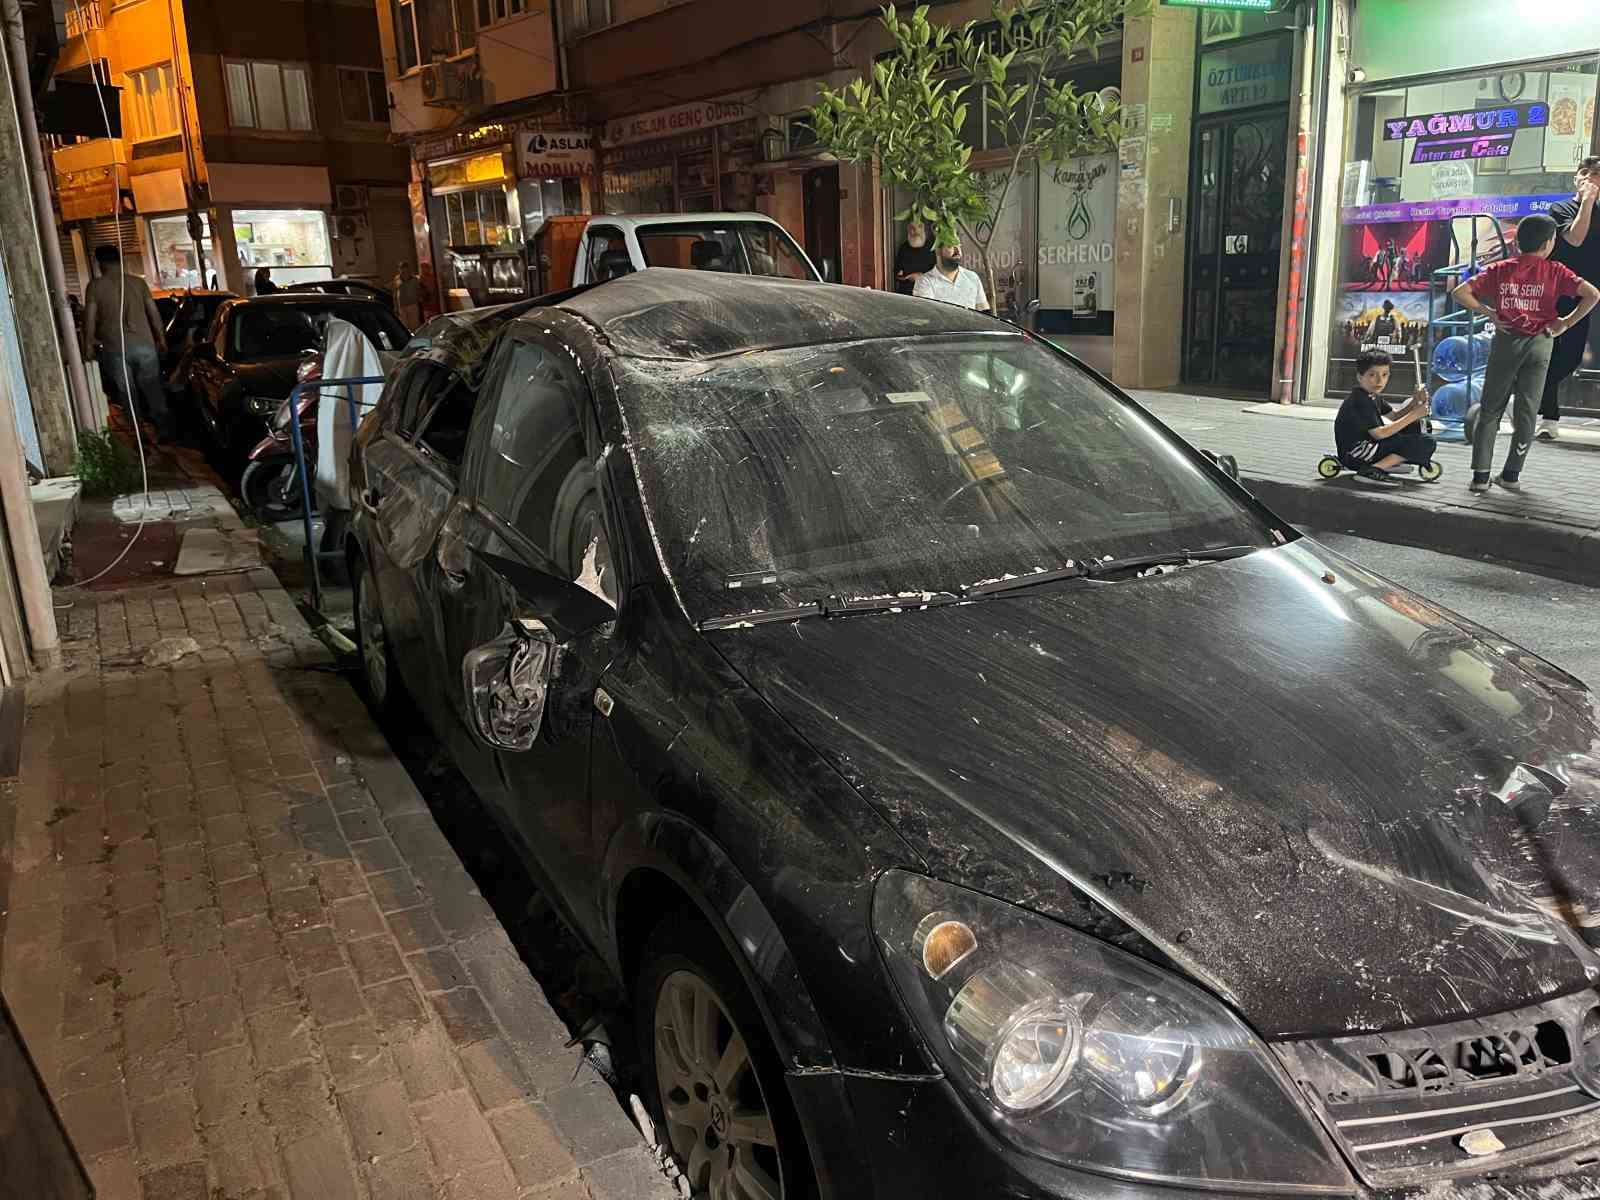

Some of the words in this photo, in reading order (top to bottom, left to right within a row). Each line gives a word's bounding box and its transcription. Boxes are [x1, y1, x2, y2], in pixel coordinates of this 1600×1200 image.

[1528, 105, 1546, 124] 2
[550, 138, 593, 150] ASLAN
[1470, 140, 1510, 157] Cafe
[1500, 282, 1519, 296] SPOR
